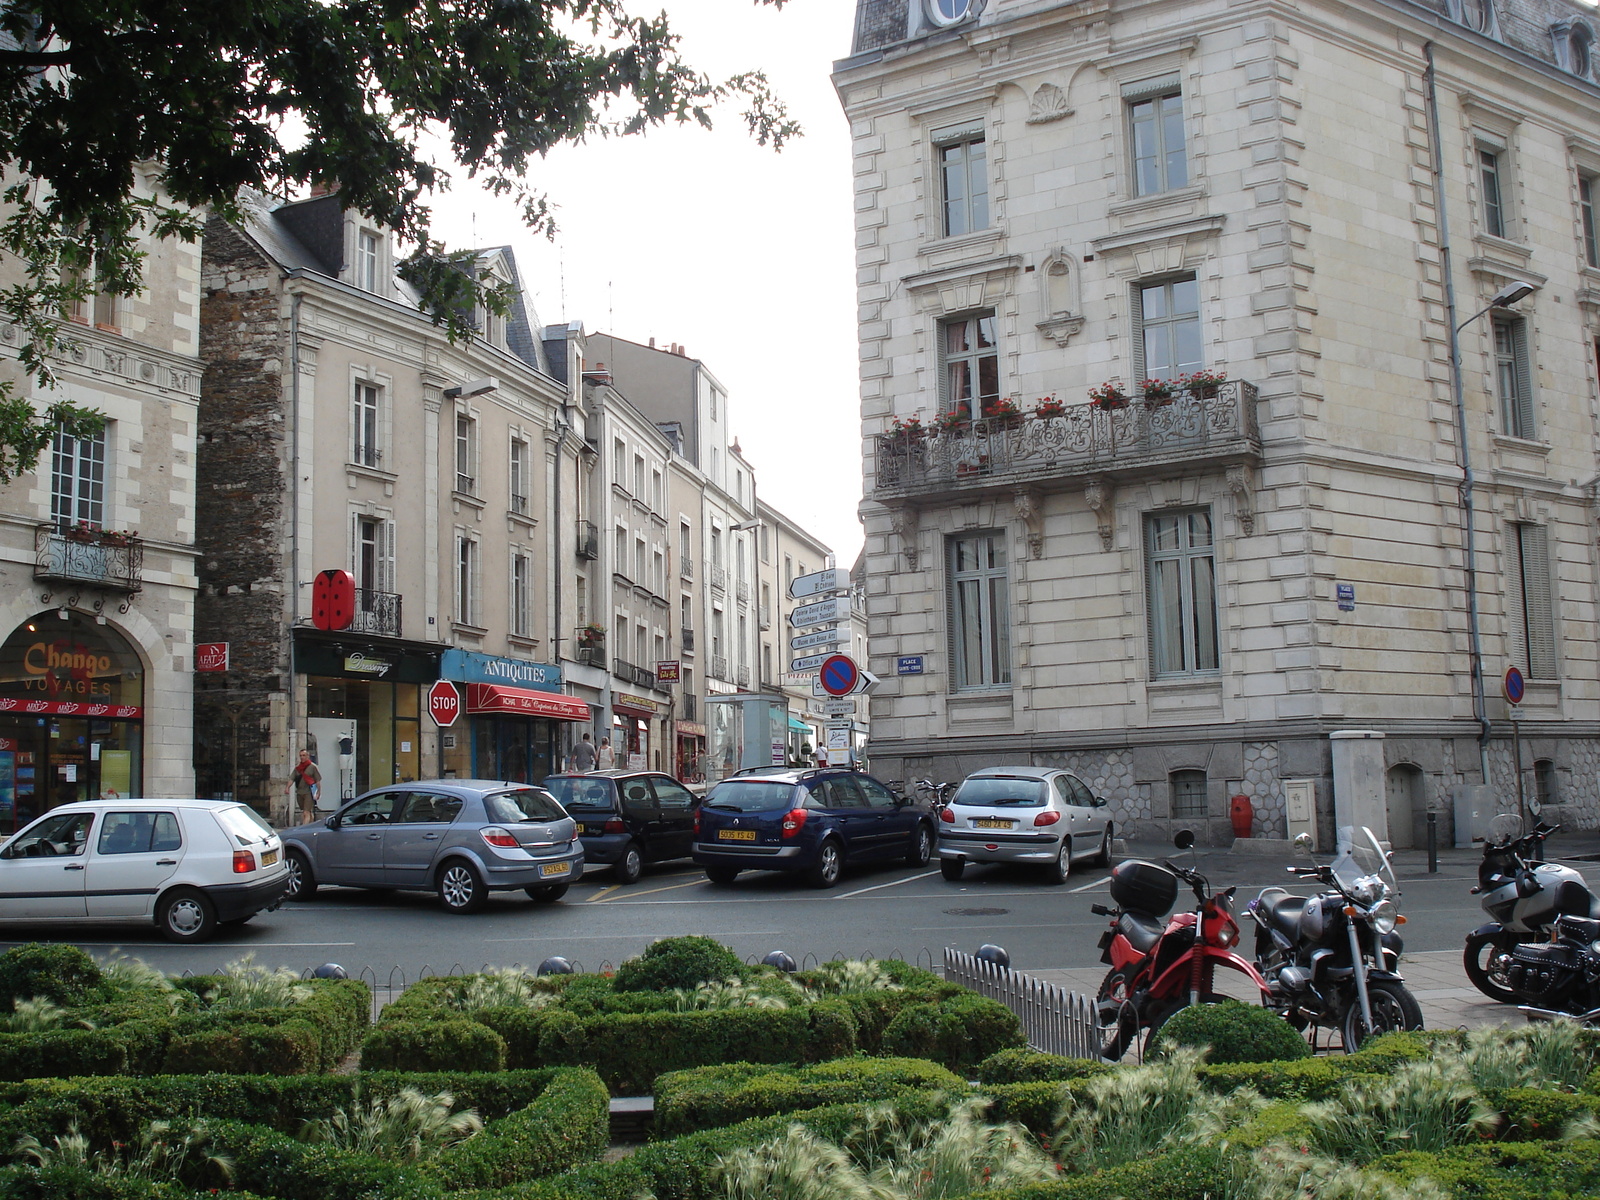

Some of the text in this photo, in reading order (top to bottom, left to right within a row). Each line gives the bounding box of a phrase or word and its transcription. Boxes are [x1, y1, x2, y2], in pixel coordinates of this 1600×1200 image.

[24, 642, 111, 679] Chango
[199, 655, 217, 664] AFAT
[484, 660, 545, 683] ANTIQUITES
[25, 679, 111, 695] VOYAGES
[432, 697, 456, 710] STOP
